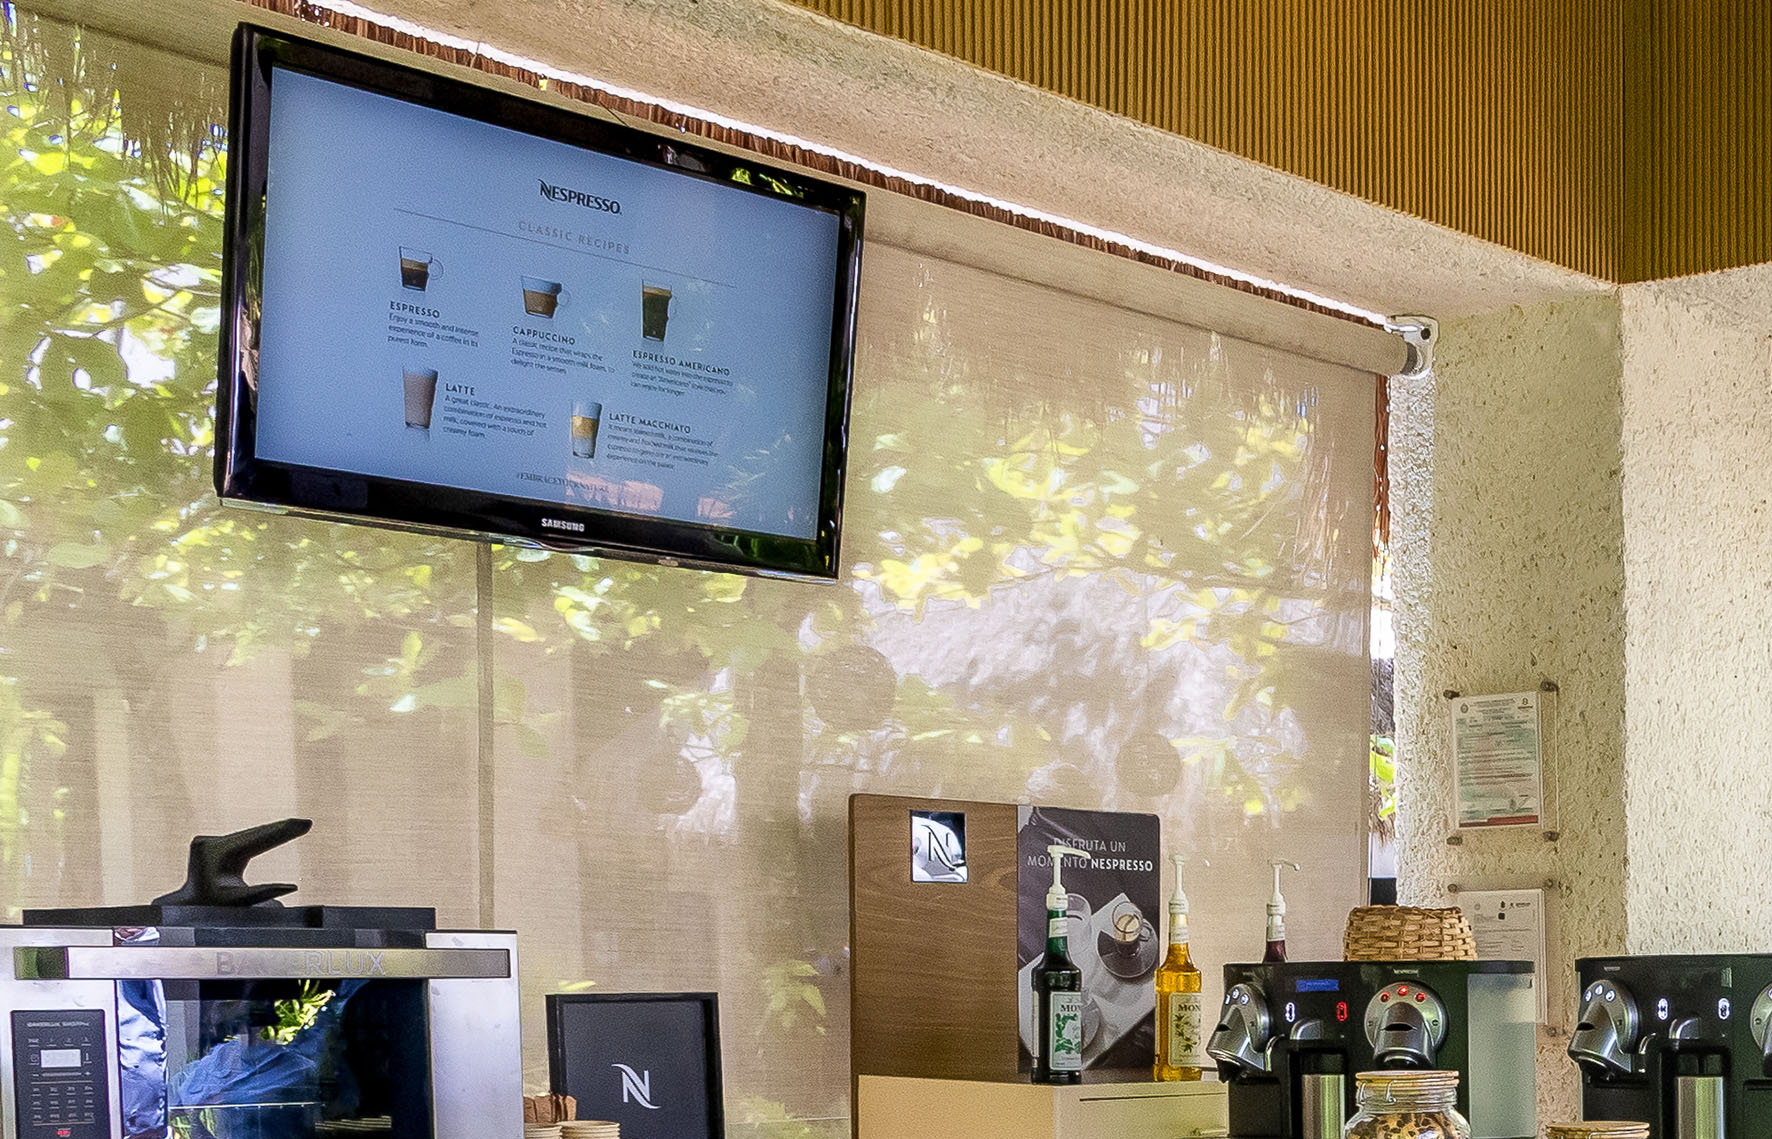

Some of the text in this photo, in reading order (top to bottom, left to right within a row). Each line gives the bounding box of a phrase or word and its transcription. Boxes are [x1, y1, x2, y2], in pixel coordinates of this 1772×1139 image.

[519, 222, 629, 254] CLASSIC RECIPES
[390, 301, 440, 318] ESPRESSO
[513, 326, 575, 345] CAPPUCCINO
[633, 351, 730, 376] ESPRESSO AMERICANO
[446, 384, 475, 395] LATTE
[609, 413, 635, 424] LATTE
[639, 419, 690, 434] MACCHIATO
[542, 518, 584, 532] SAMSUNG
[921, 824, 957, 871] N
[1110, 841, 1125, 852] UN
[1027, 855, 1152, 871] MOMNTO NESPRESSO
[217, 951, 385, 975] BARLUX
[611, 1063, 662, 1109] N
